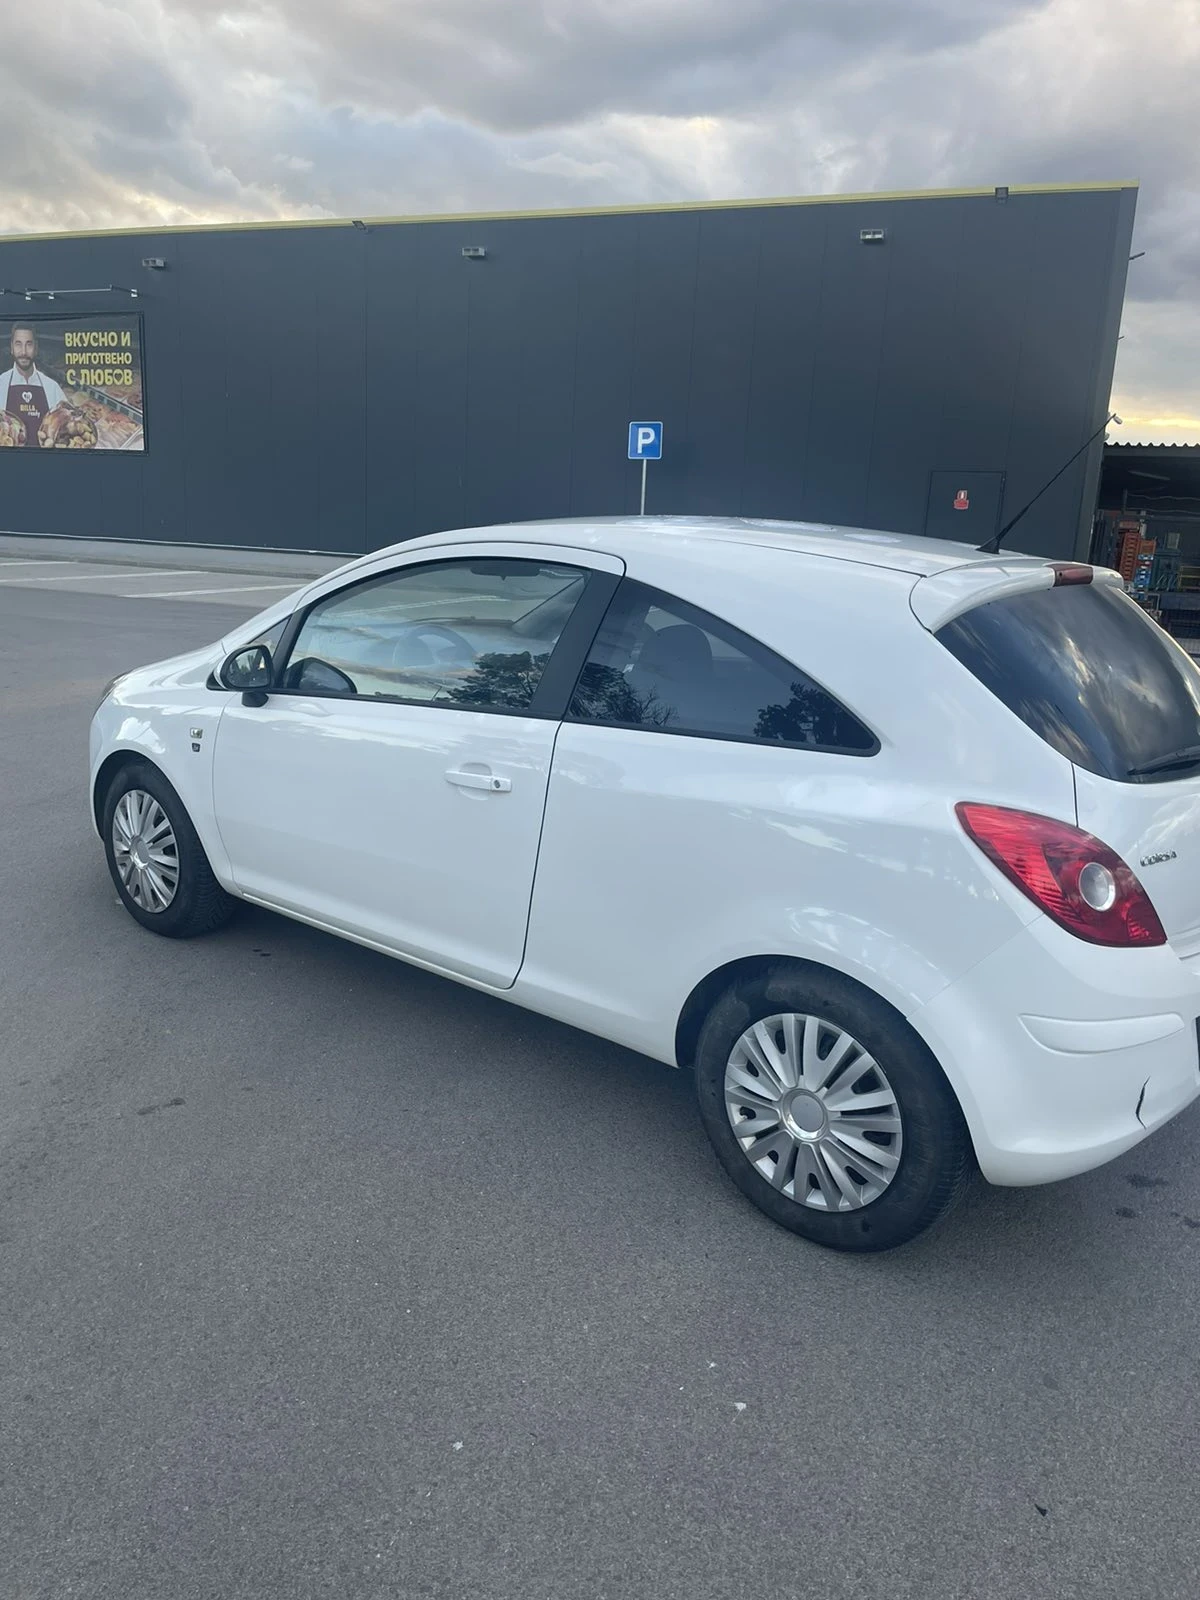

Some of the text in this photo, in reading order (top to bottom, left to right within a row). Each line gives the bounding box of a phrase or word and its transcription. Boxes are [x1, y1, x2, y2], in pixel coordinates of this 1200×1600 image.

[64, 331, 131, 347] ВКУСНО И
[65, 352, 132, 365] ПРИГОТВЕНО
[66, 368, 133, 386] С ЛЮБОВ
[637, 427, 655, 454] P
